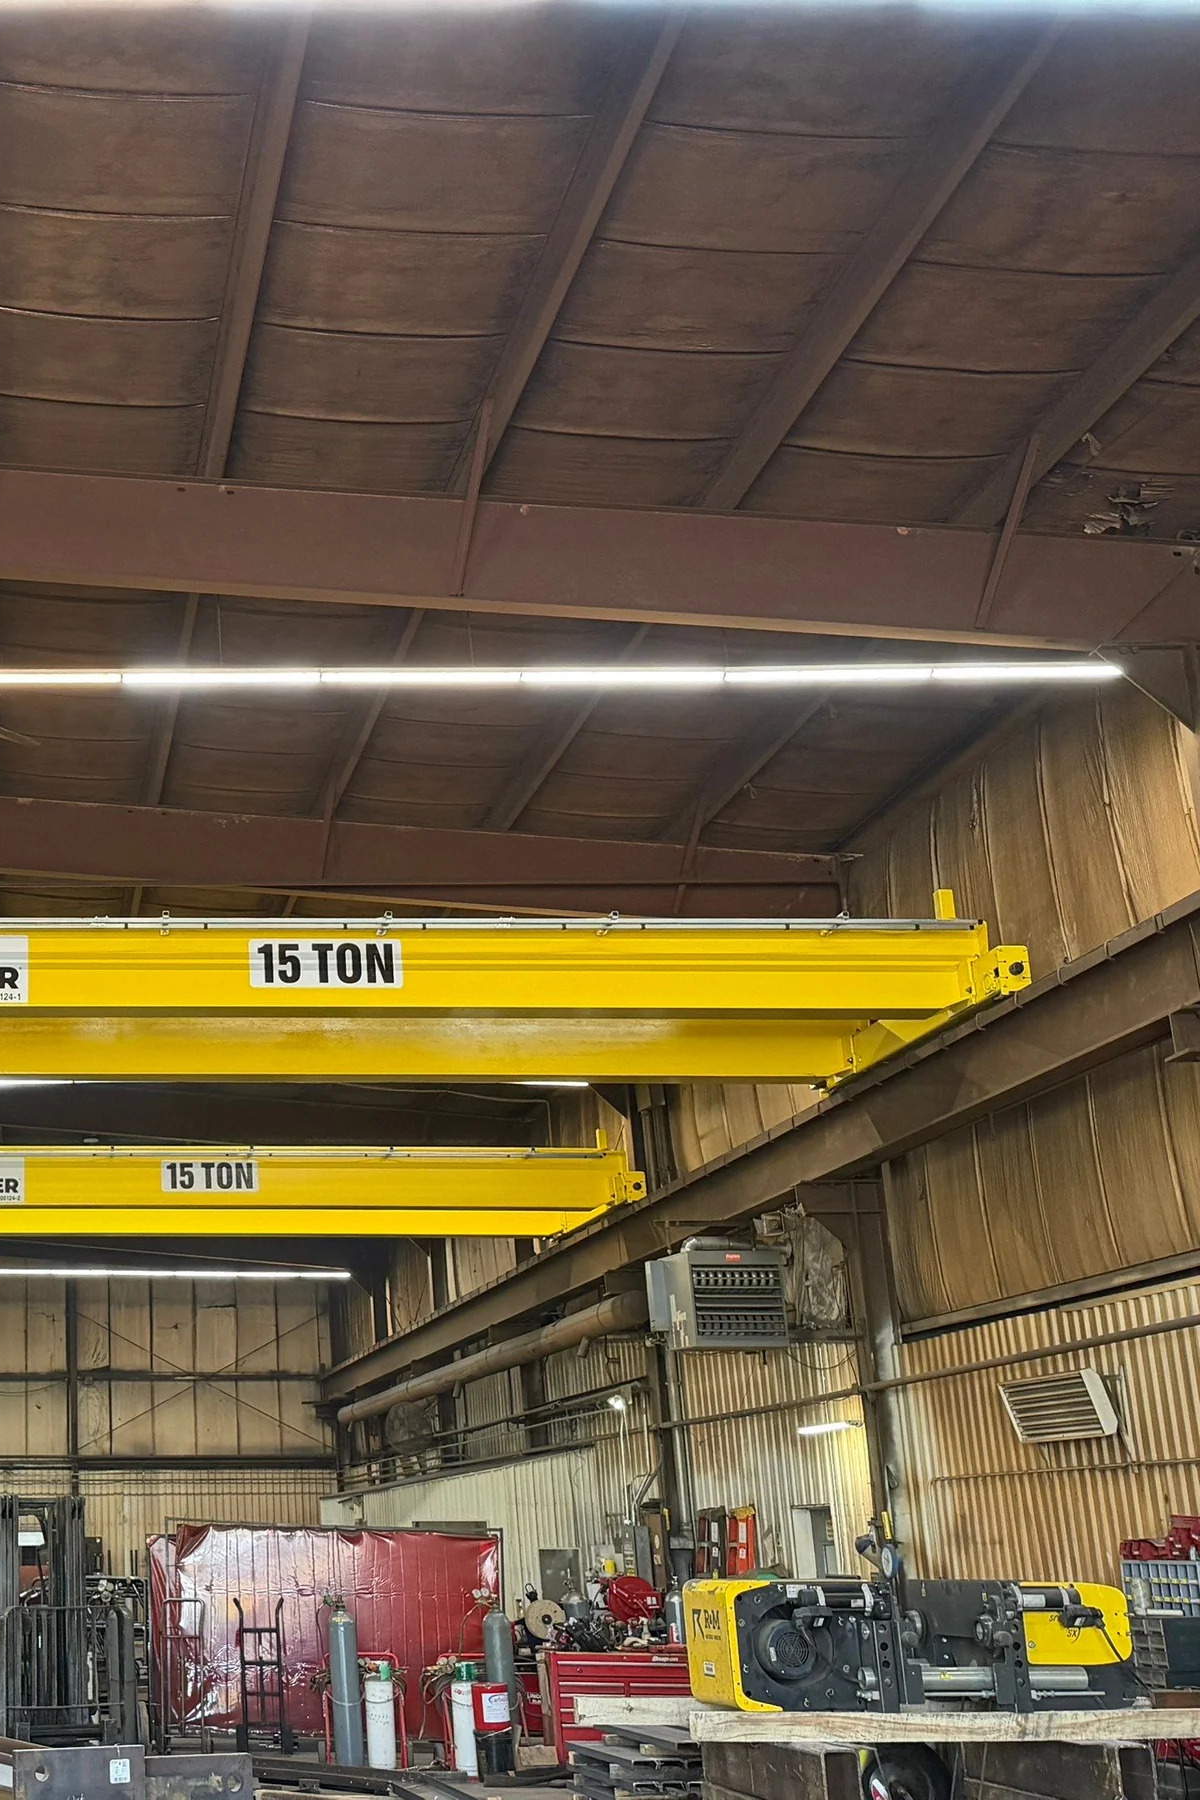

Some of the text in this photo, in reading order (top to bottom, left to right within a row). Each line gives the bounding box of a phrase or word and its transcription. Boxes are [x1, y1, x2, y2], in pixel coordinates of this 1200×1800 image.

[257, 943, 395, 984] 15 TON
[166, 1162, 254, 1189] 15 TON
